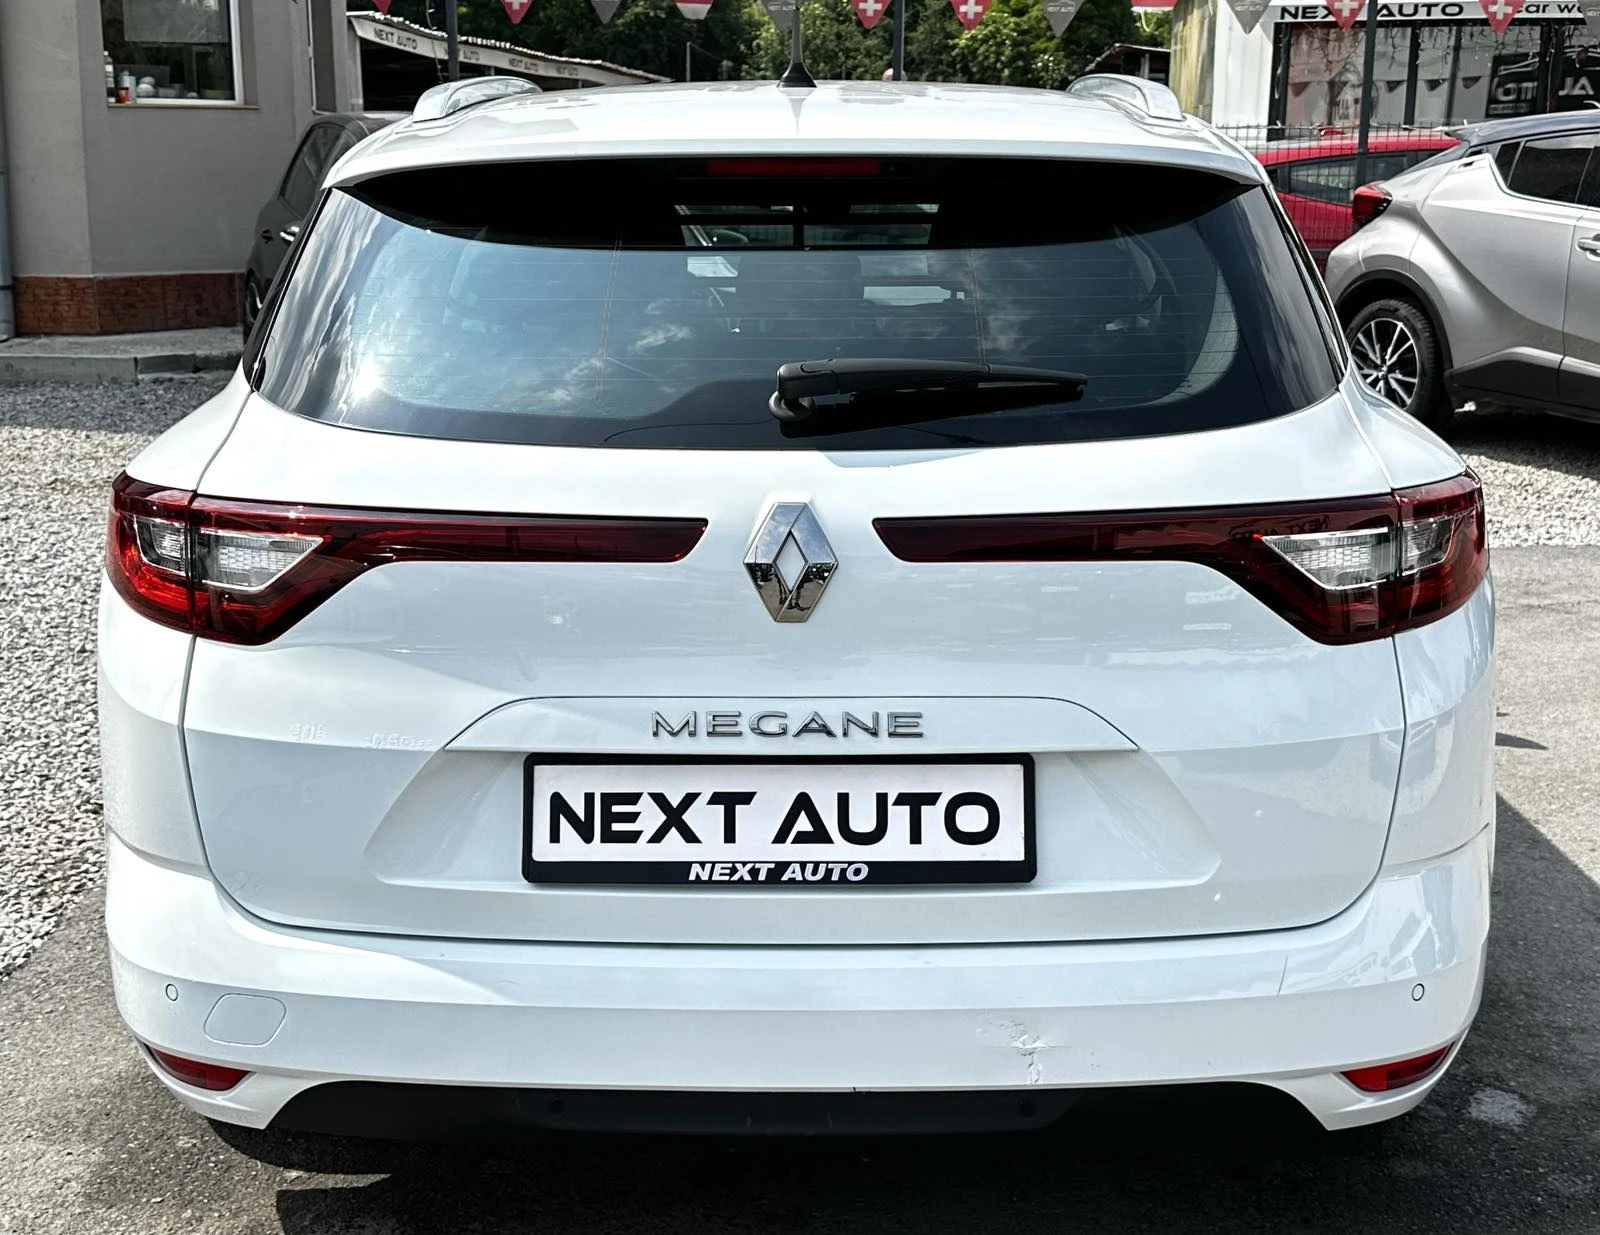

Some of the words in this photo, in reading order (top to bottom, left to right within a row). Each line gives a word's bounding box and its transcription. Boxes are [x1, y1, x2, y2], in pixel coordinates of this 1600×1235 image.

[1375, 4, 1464, 19] AUTO
[1517, 4, 1550, 14] ar
[652, 711, 924, 738] MEGANE
[549, 791, 757, 844] NEXT
[771, 791, 1000, 845] AUTO
[689, 862, 774, 882] NEXT
[780, 862, 869, 882] AUTO
